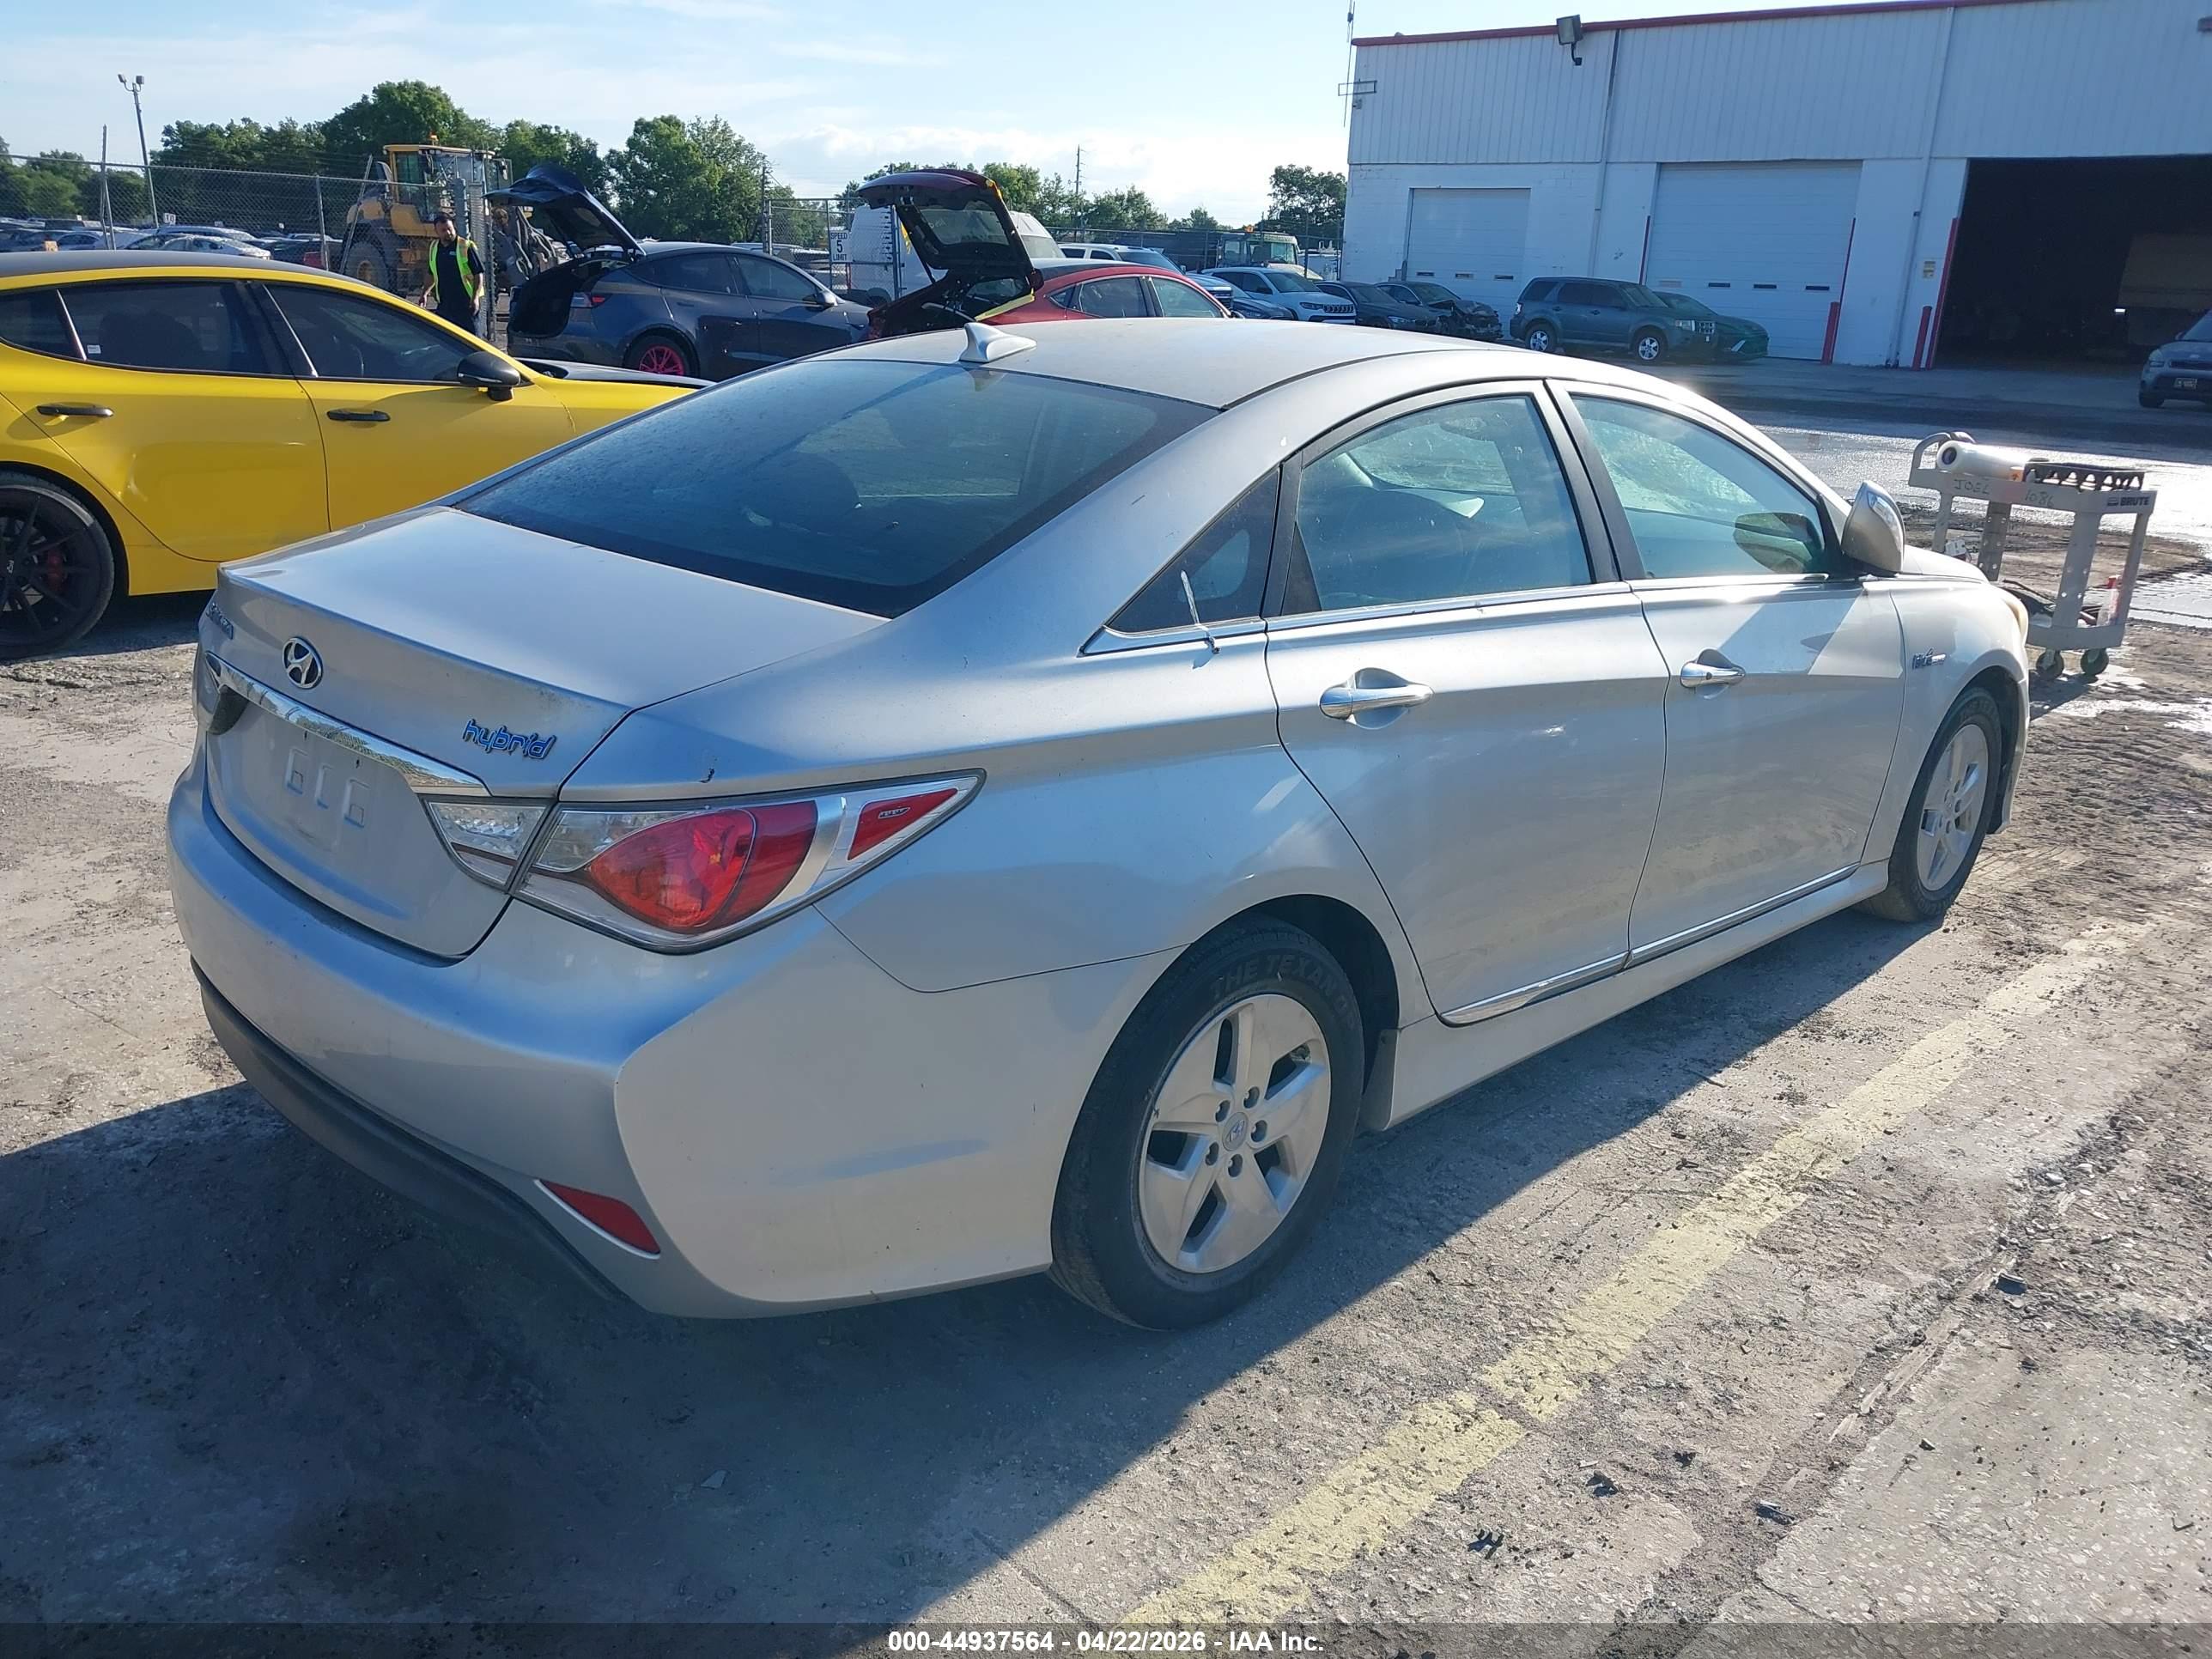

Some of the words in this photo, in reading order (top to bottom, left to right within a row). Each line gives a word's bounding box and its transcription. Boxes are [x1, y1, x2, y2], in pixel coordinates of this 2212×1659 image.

[836, 240, 843, 253] 5
[2119, 495, 2150, 507] BRUTE
[462, 718, 557, 760] hybrid
